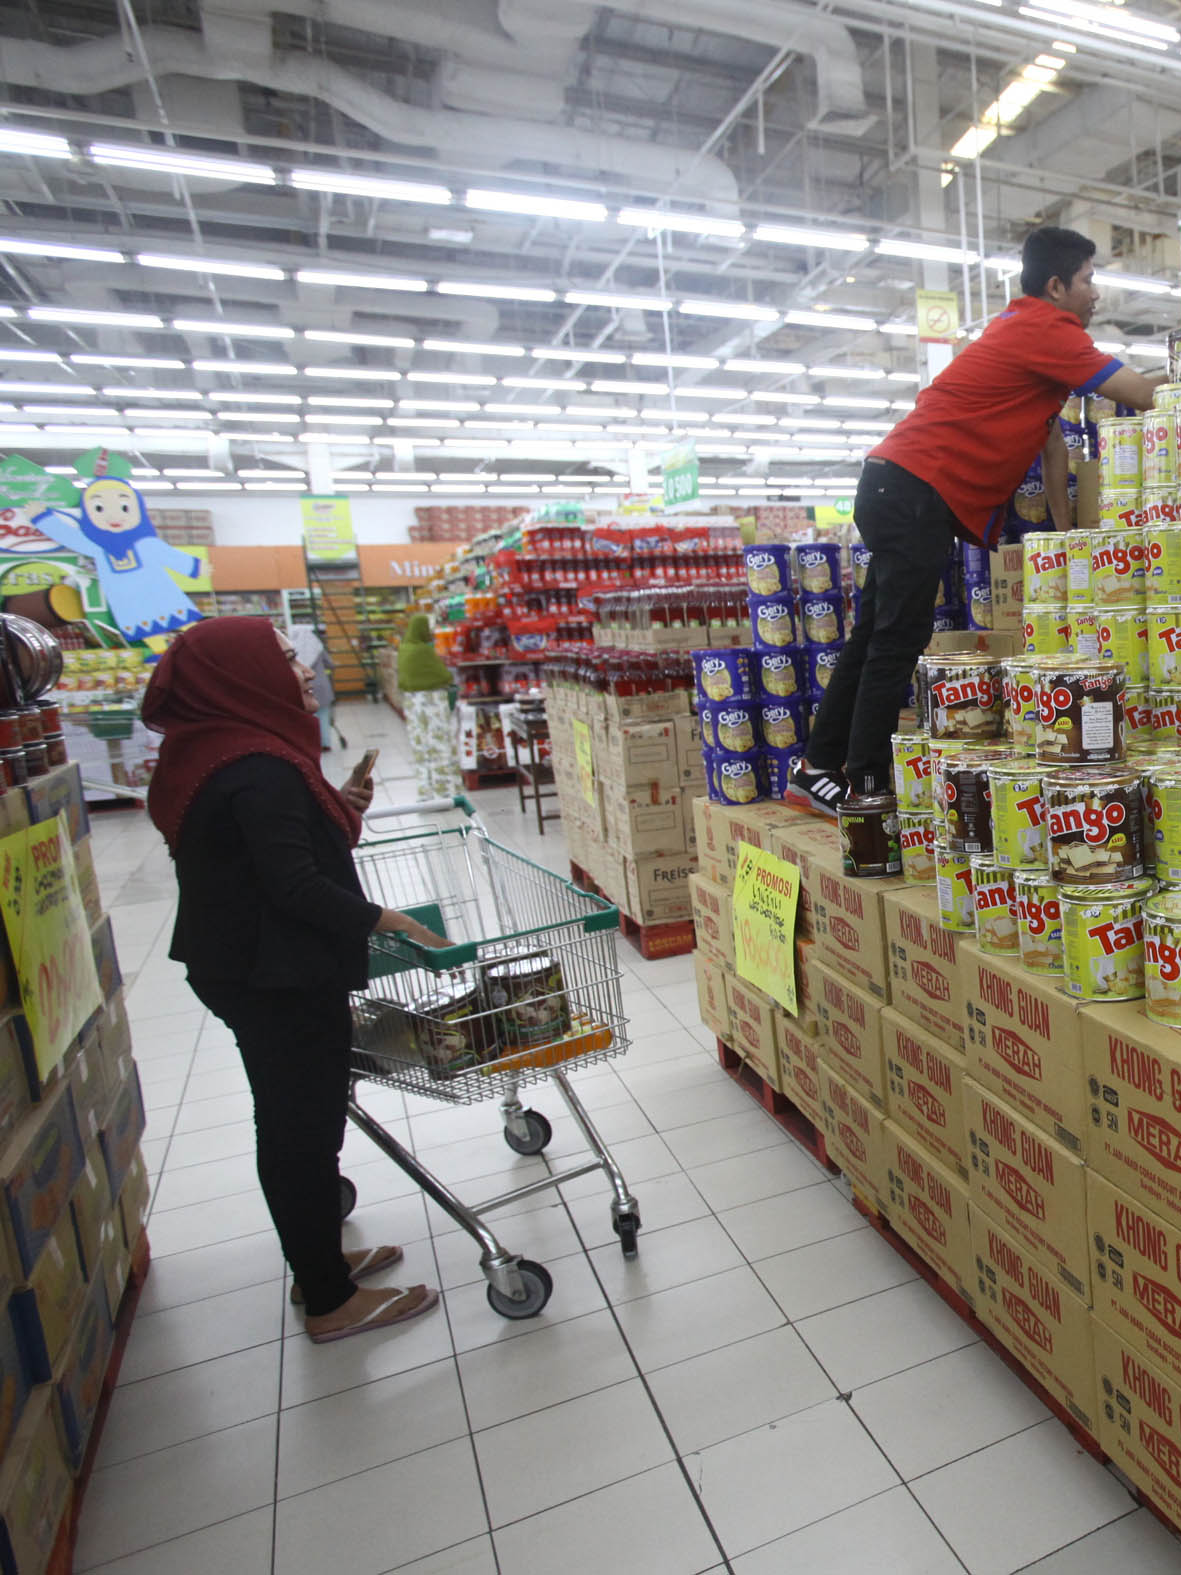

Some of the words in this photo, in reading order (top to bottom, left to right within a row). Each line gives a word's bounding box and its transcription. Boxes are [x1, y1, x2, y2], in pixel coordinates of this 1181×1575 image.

[1028, 552, 1066, 574] Tan
[1092, 545, 1145, 575] ango
[1080, 676, 1113, 691] Tango
[1050, 803, 1125, 844] ango
[756, 867, 792, 899] PROMOSI
[1089, 917, 1143, 956] Tan
[978, 965, 1014, 1018] KHONG
[1017, 988, 1050, 1041] GUAN
[992, 1025, 1042, 1081] MERAH
[1108, 1035, 1163, 1102] KHONG
[981, 1099, 1017, 1157] KHONG
[1020, 1129, 1055, 1186] GUAN
[994, 1158, 1046, 1222] MERAH
[1114, 1200, 1168, 1272] KHONG
[987, 1228, 1024, 1288] KHONG
[1028, 1266, 1062, 1324] GUAN
[1001, 1286, 1053, 1355] MERAH
[1121, 1350, 1173, 1427] KHONG
